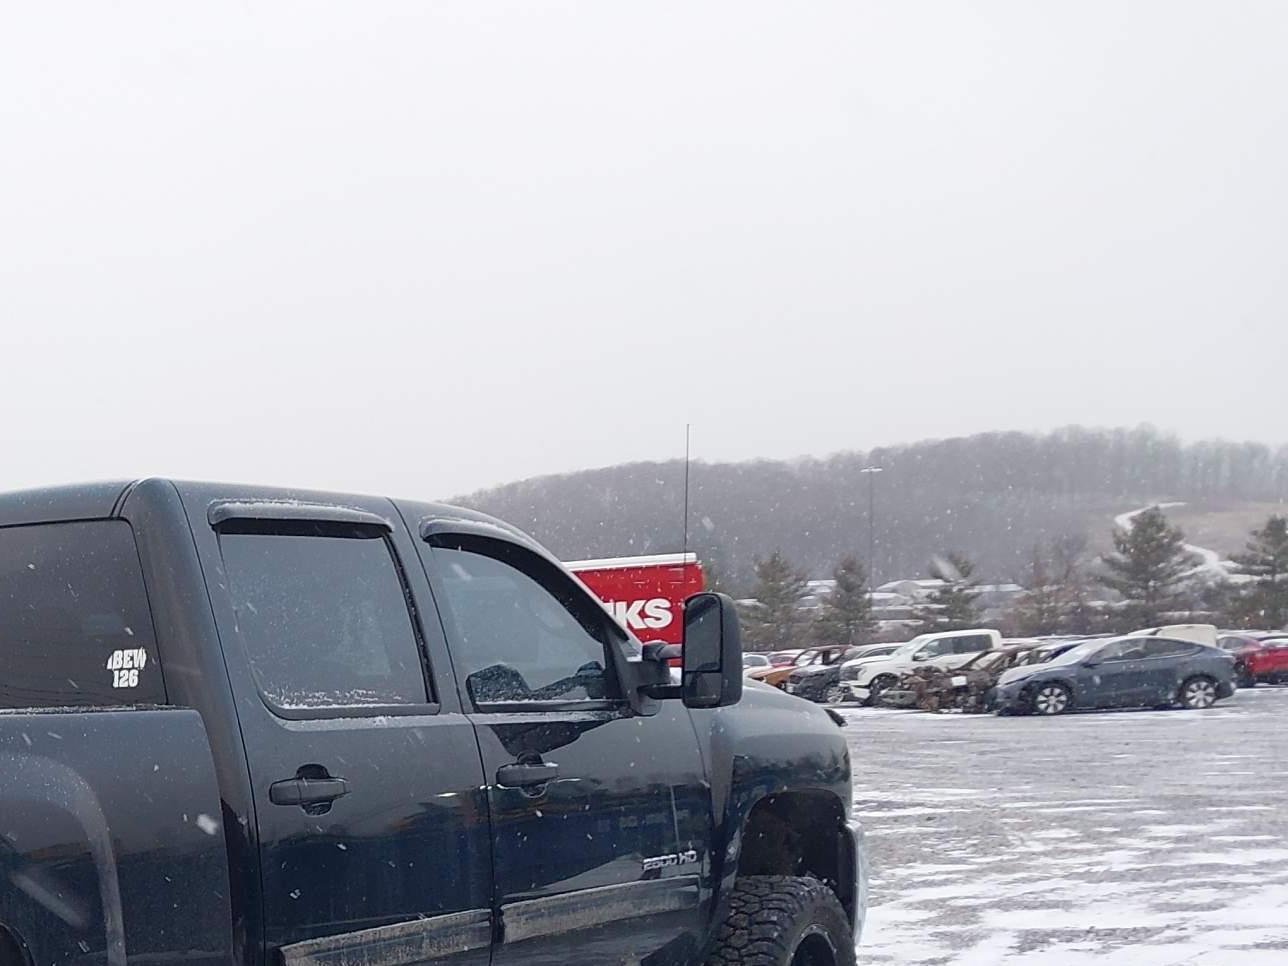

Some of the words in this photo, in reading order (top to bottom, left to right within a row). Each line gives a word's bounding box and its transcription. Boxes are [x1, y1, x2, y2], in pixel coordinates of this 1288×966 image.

[602, 597, 673, 630] KS
[112, 669, 139, 688] 126
[678, 849, 697, 865] HD
